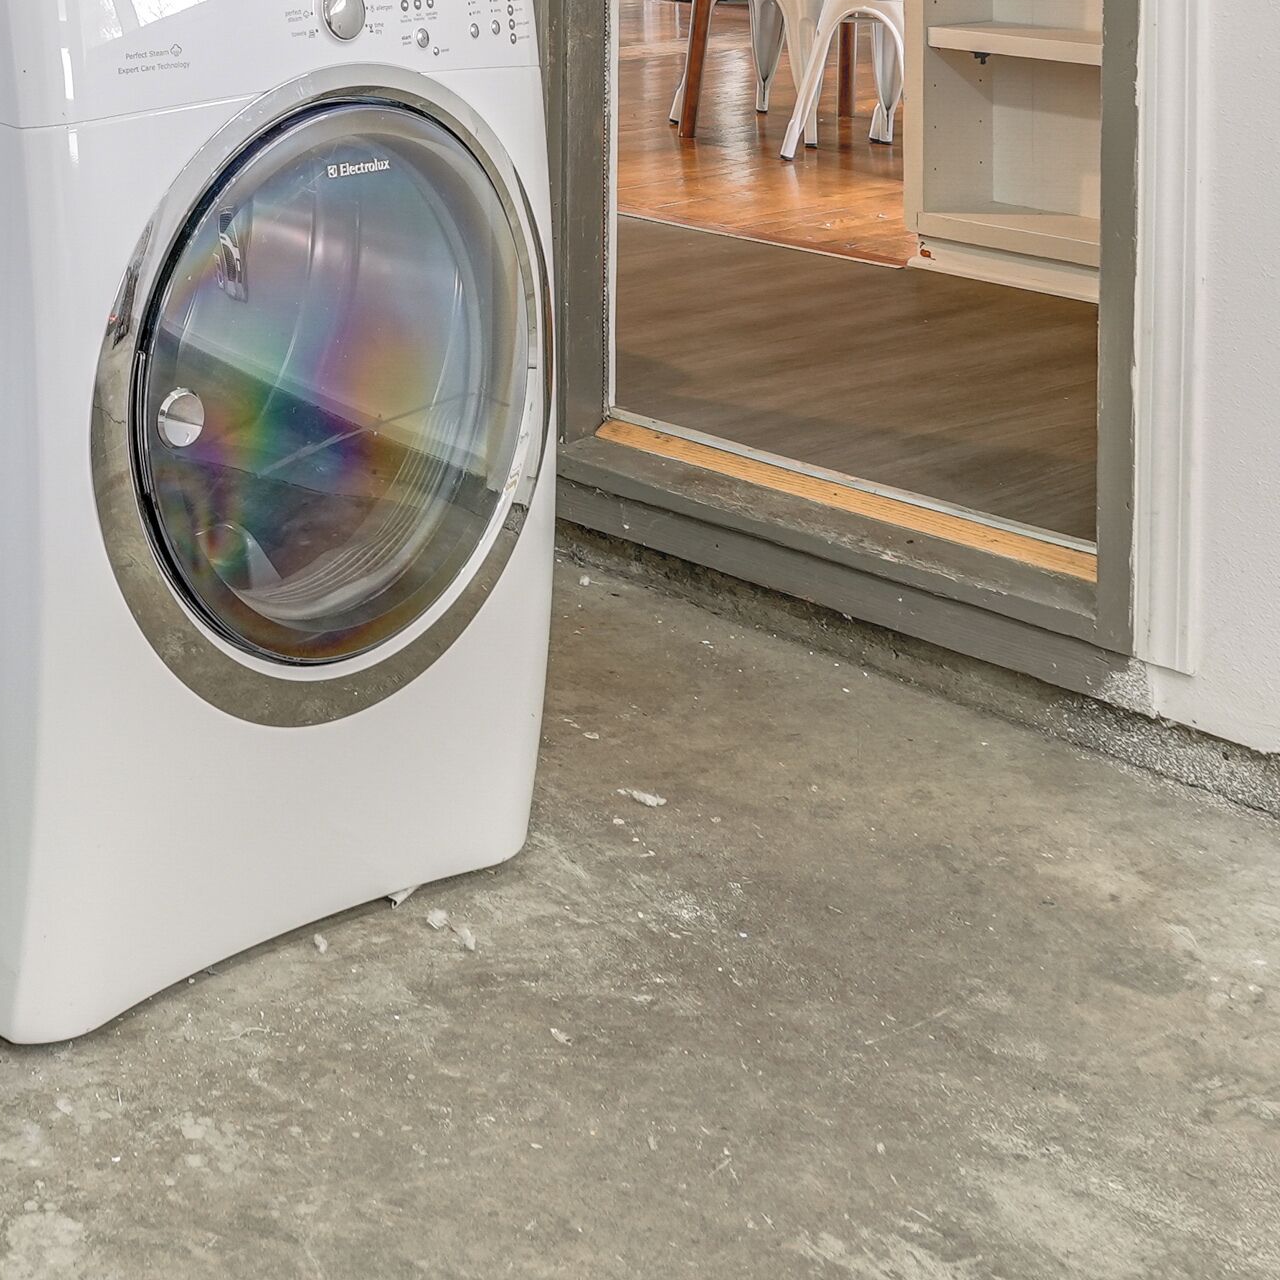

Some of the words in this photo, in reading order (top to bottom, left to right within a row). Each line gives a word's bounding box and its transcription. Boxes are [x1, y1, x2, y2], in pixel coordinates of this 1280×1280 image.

[125, 51, 148, 60] Perfect
[149, 49, 170, 57] Steam
[118, 66, 139, 75] Expert
[140, 64, 156, 72] Care
[157, 61, 190, 70] Technology
[340, 158, 391, 177] Electrolux
